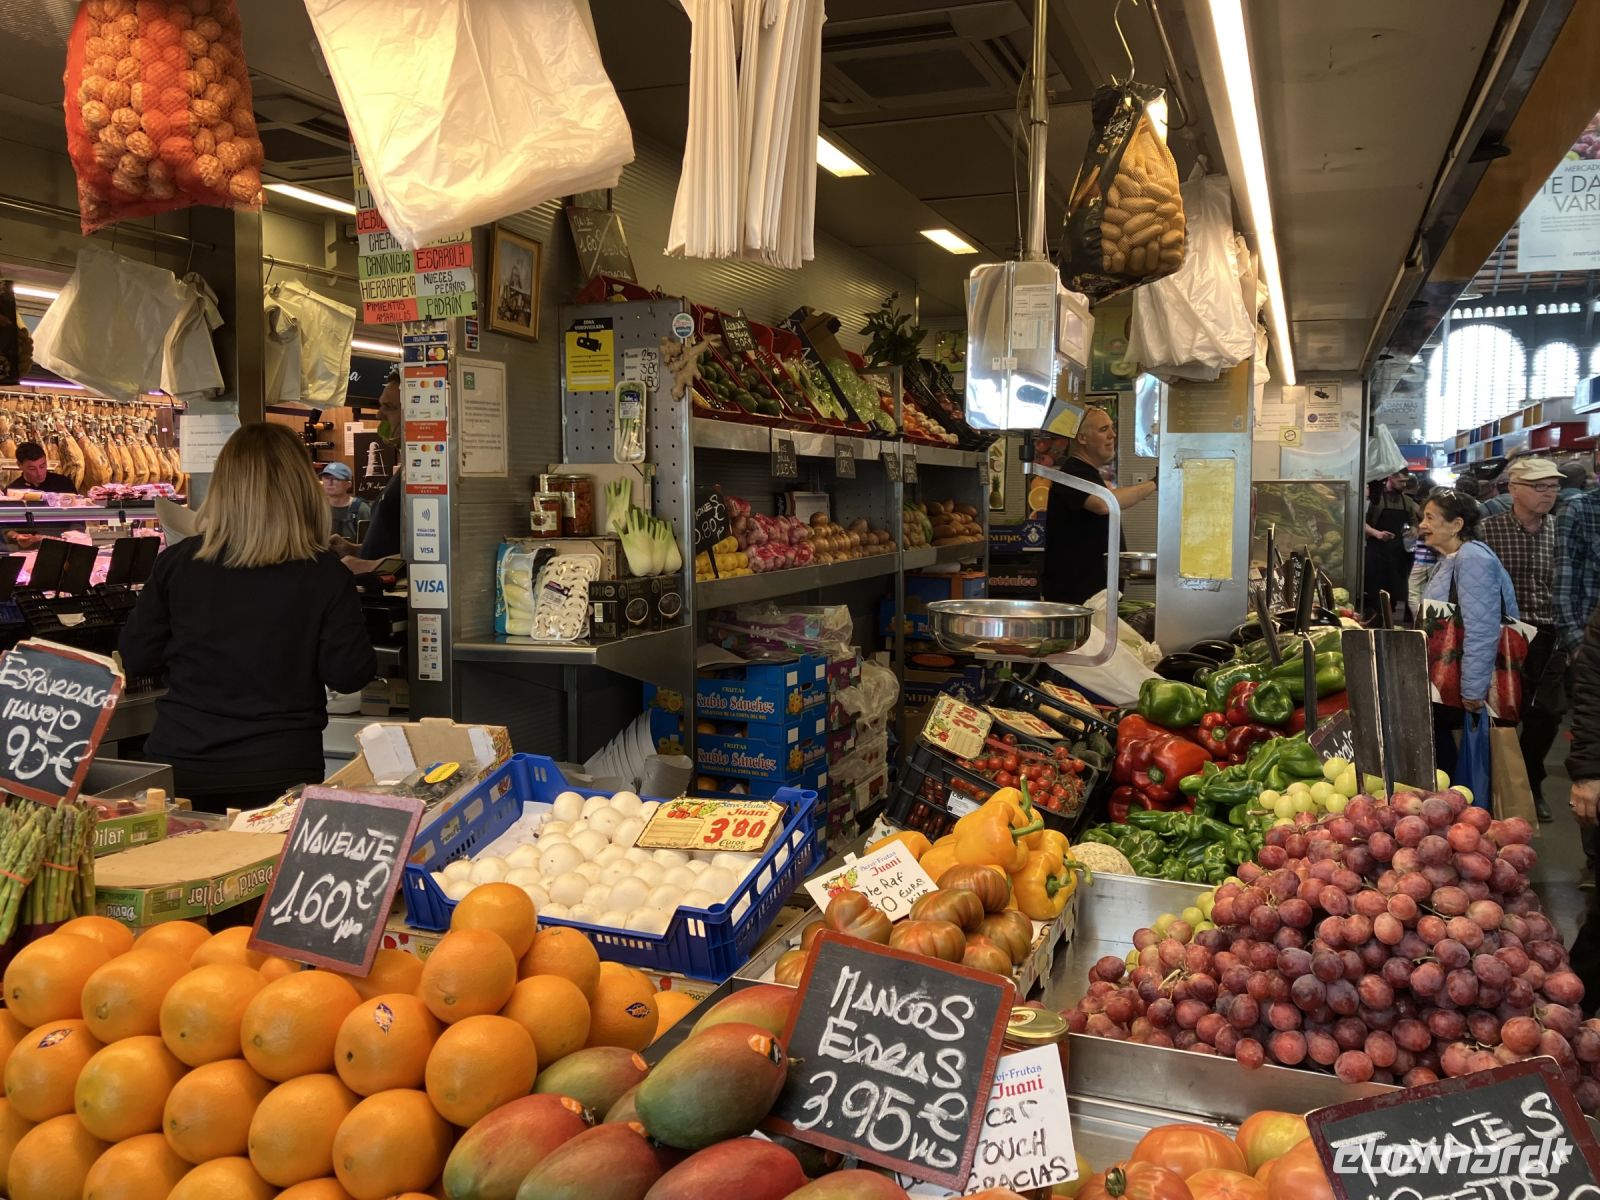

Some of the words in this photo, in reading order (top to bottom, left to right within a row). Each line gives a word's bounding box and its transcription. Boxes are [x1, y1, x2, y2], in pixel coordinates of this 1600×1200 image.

[1571, 174, 1600, 193] DA
[358, 211, 388, 230] CEBOL
[368, 232, 402, 252] CHER
[416, 246, 465, 269] ESCAROLA
[361, 276, 416, 300] HIERBABUENA
[423, 271, 453, 285] NUECES
[366, 300, 406, 311] PIMIENTOS
[376, 310, 411, 322] AMARILLOS
[414, 579, 445, 593] VISA
[729, 695, 775, 714] Sánchez
[731, 751, 776, 771] Sánchez
[727, 807, 769, 817] Juani
[870, 856, 902, 877] Juani
[239, 865, 274, 897] David
[187, 880, 225, 909] Pilar
[106, 904, 137, 921] David
[830, 965, 975, 1042] MANGOS
[991, 1074, 1045, 1100] Juani
[1330, 1091, 1566, 1187] TOMATES
